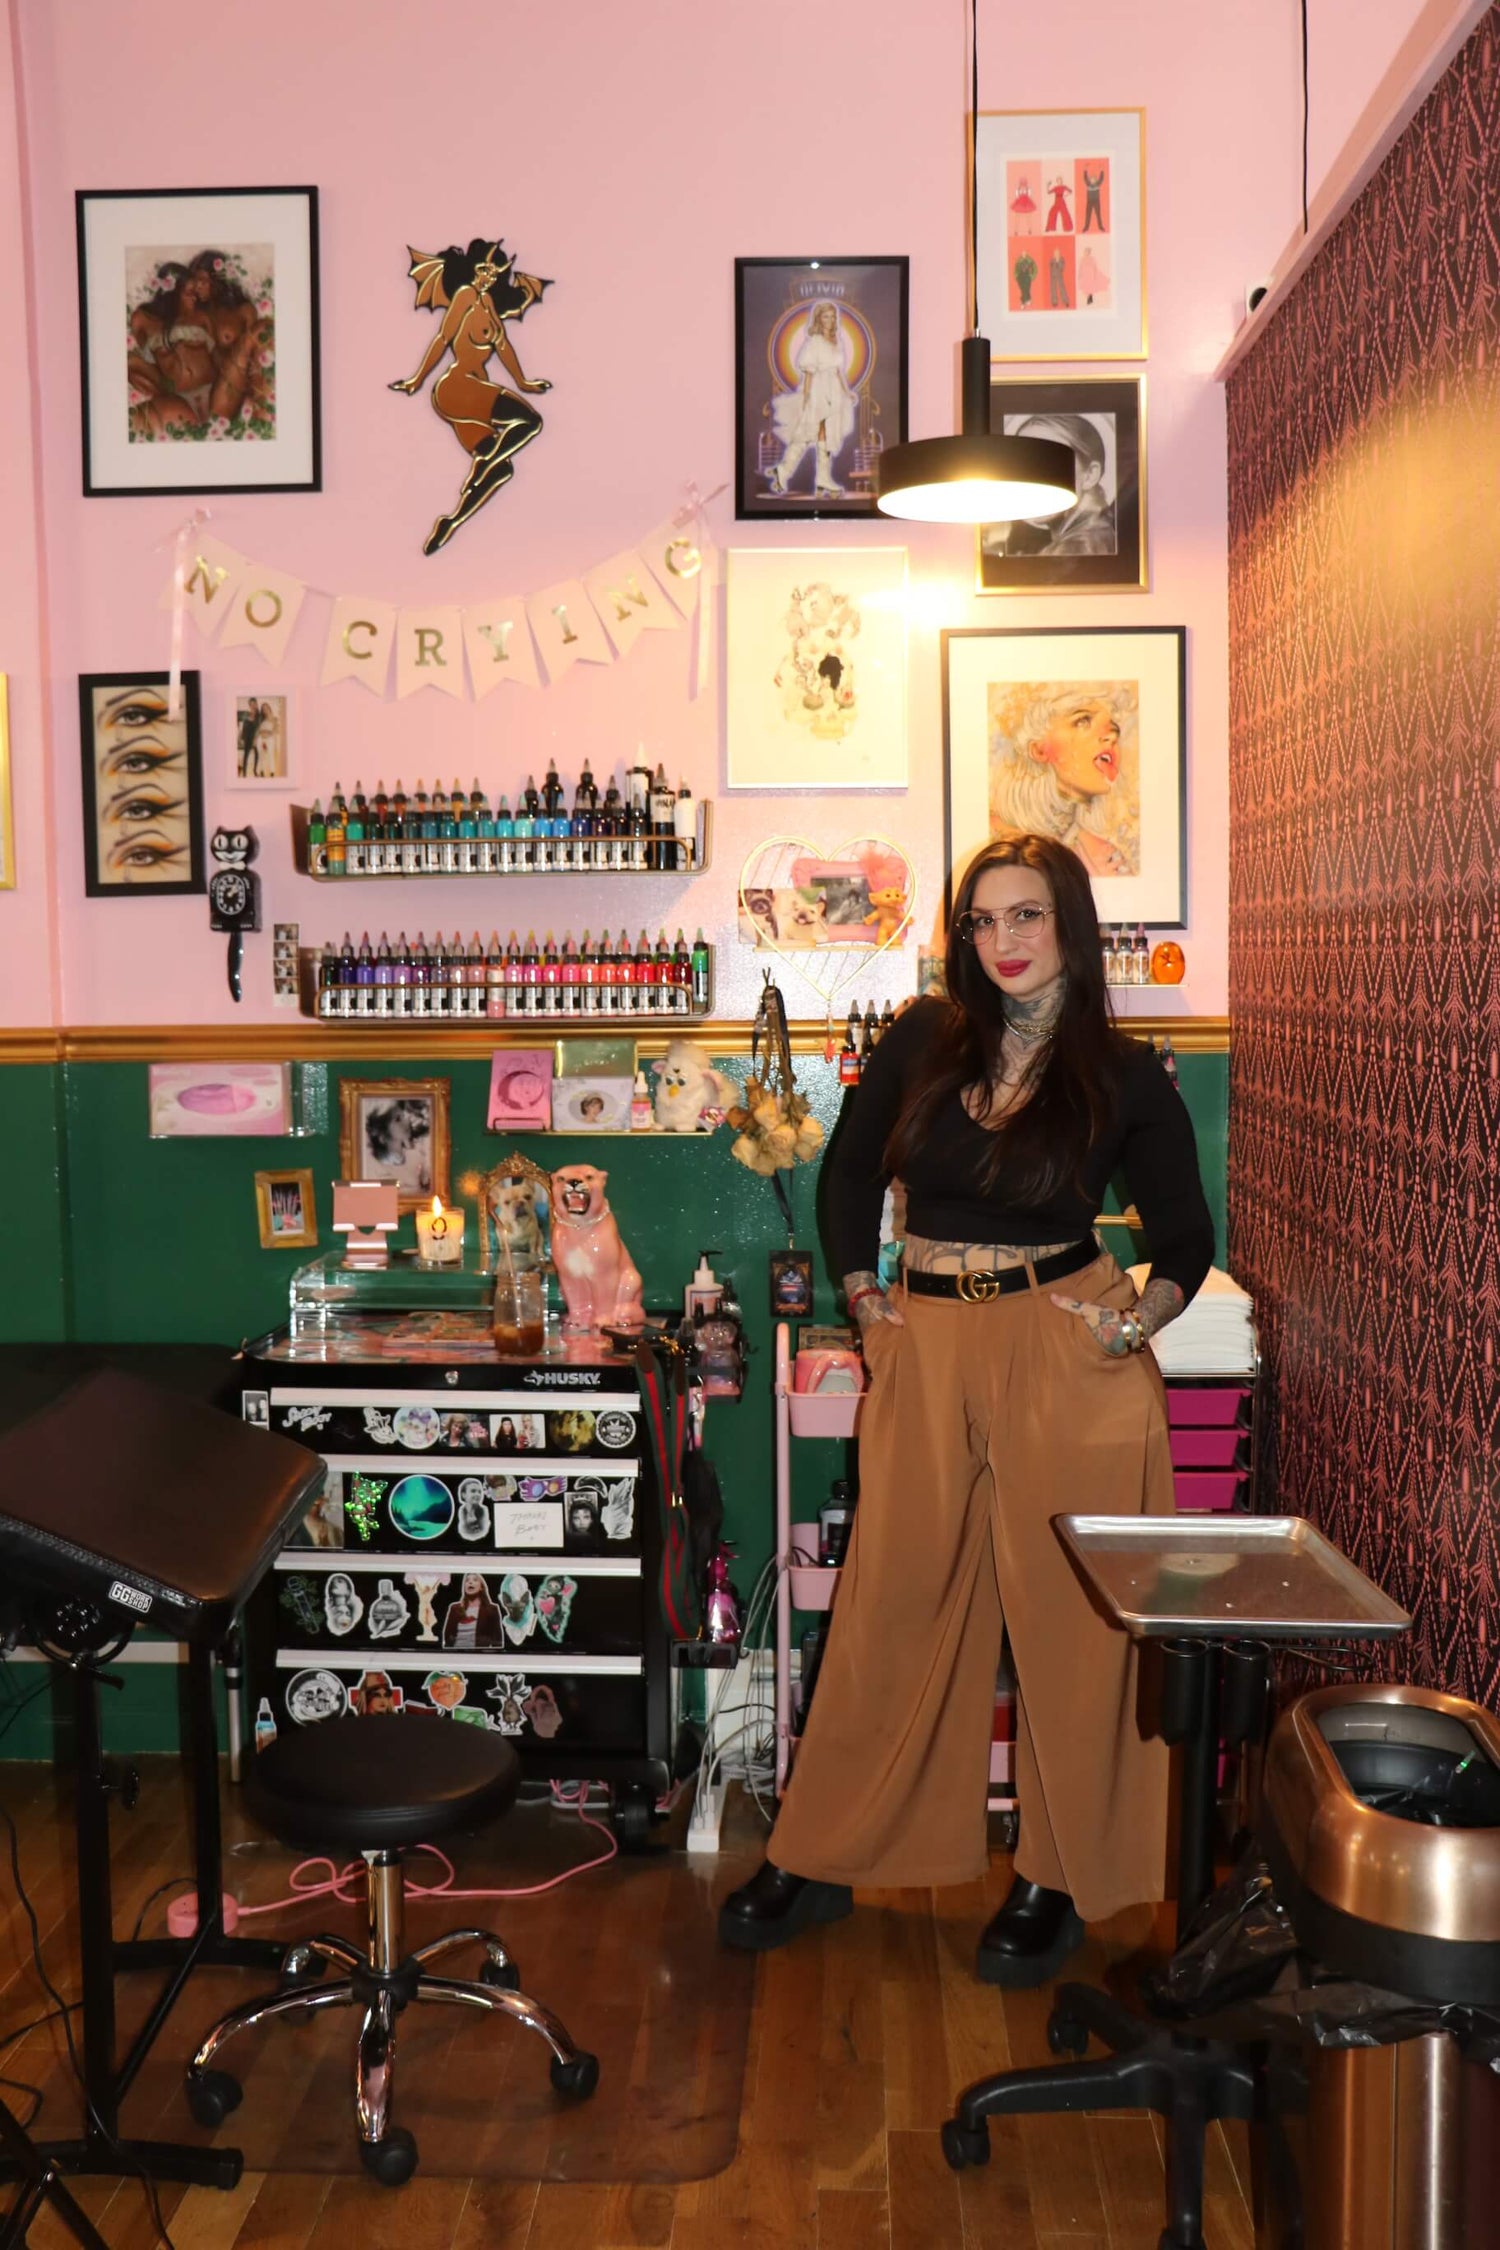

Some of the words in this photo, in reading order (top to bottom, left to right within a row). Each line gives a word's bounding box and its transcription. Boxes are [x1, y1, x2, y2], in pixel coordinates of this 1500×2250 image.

[184, 554, 282, 628] NO
[342, 537, 702, 666] CRYING
[111, 1583, 131, 1601] GG
[130, 1591, 150, 1603] WORK
[128, 1597, 149, 1610] SHOP
